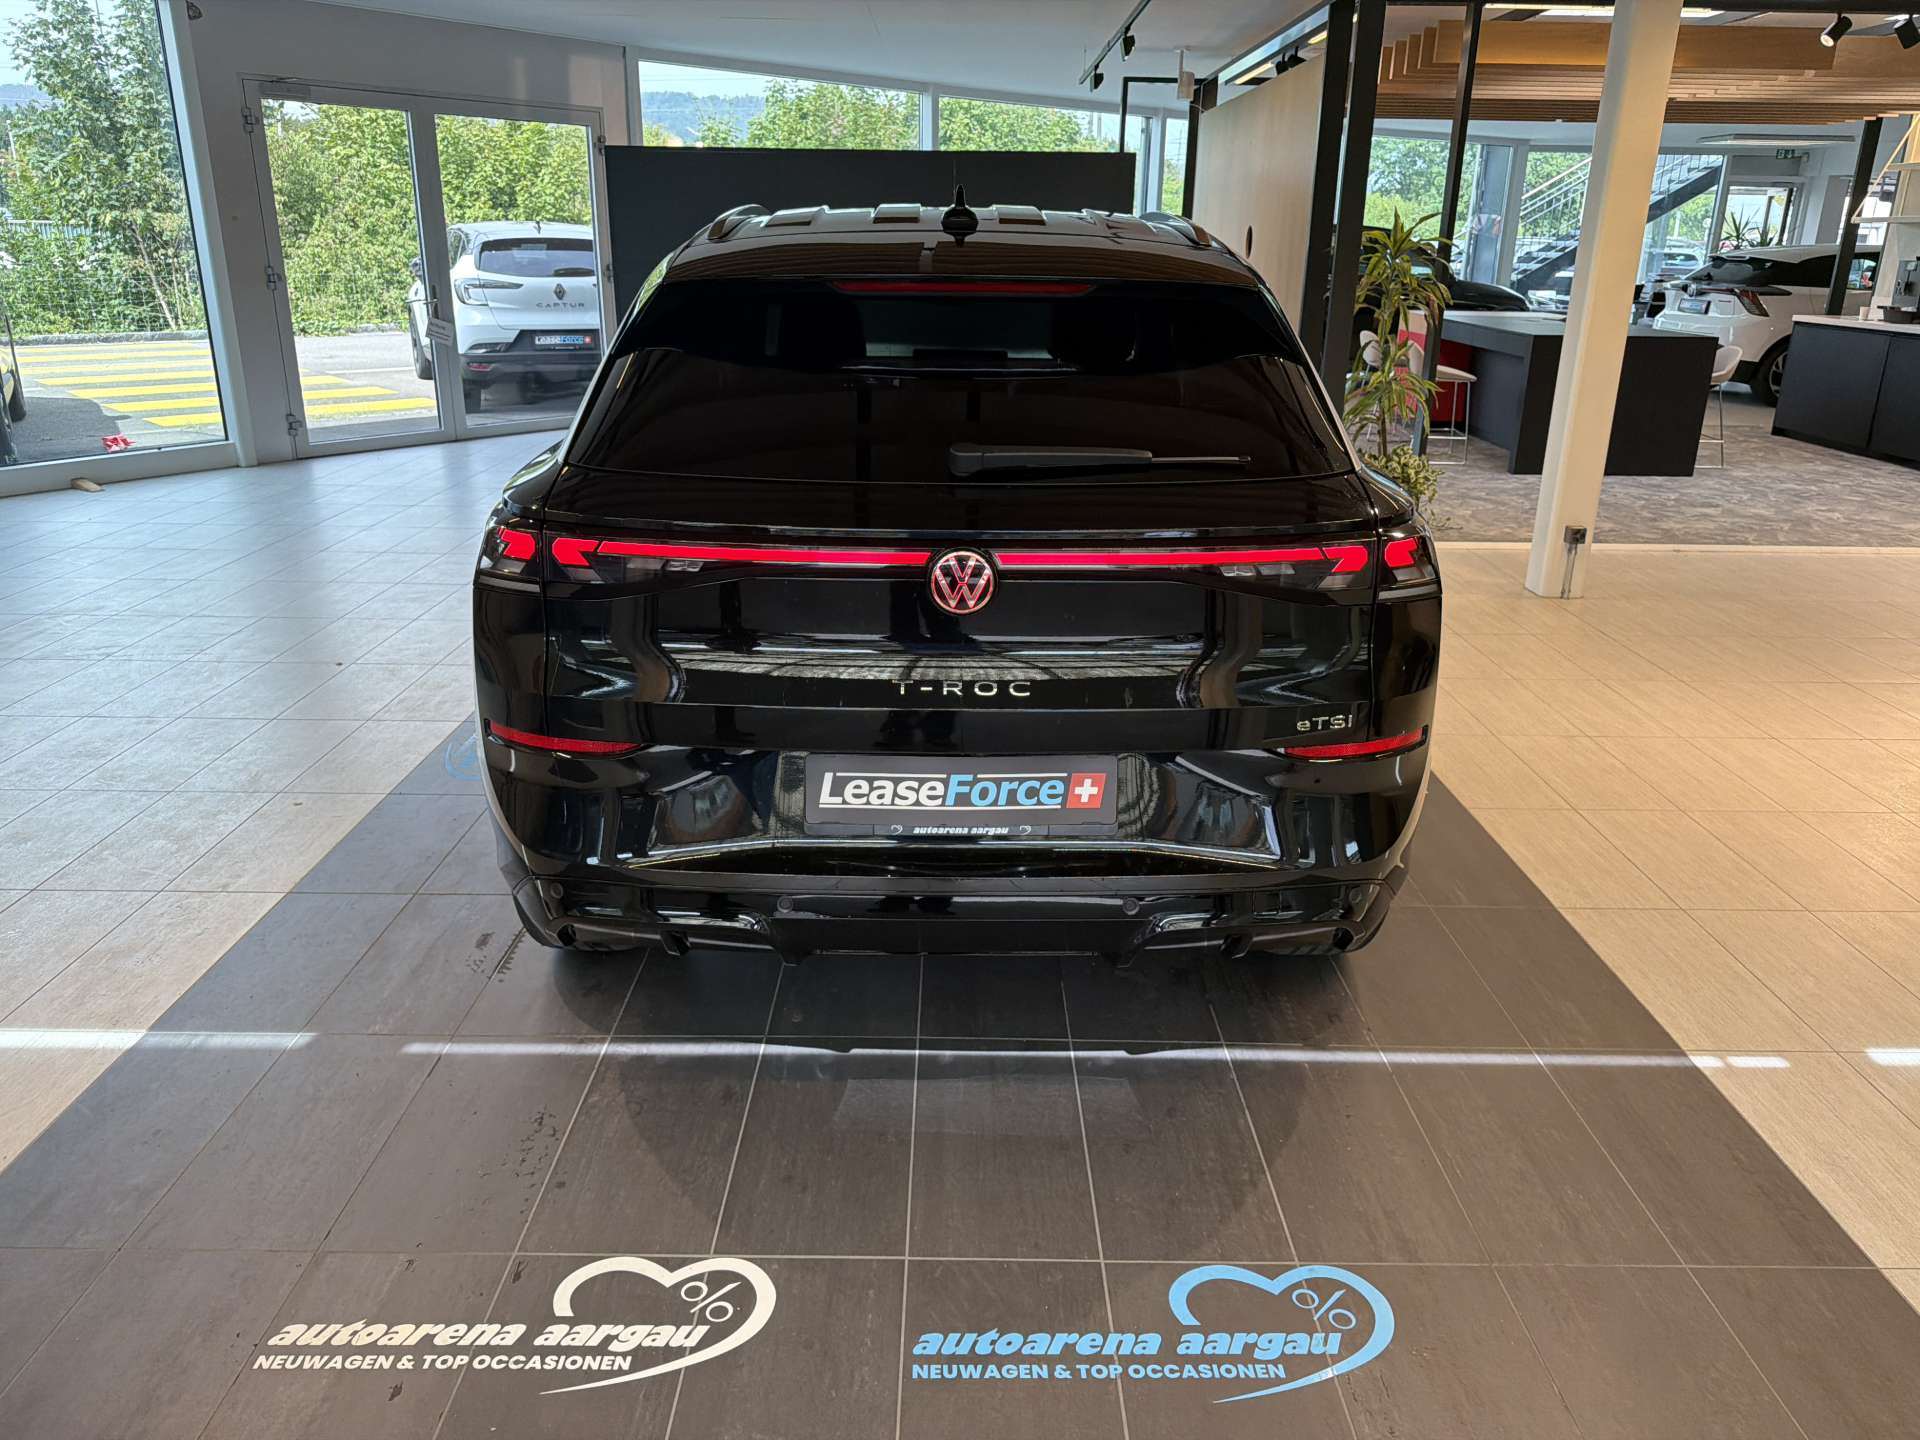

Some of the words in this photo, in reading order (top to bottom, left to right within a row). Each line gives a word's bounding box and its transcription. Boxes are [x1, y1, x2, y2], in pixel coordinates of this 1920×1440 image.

[892, 680, 1031, 696] T-ROC
[819, 772, 1064, 807] LeaseForce
[913, 826, 968, 834] autoarena
[970, 827, 1009, 835] aargau
[267, 1318, 527, 1347] autoarena
[533, 1323, 710, 1353] aargau
[911, 1327, 1161, 1357] autoarena
[1176, 1331, 1343, 1360] aargau
[252, 1354, 394, 1370] NEUWAGEN
[396, 1354, 416, 1370] &
[422, 1354, 469, 1370] TOP
[472, 1355, 632, 1372] OCCASIONEN
[911, 1363, 1049, 1380] NEUWAGEN
[1053, 1363, 1073, 1380] &
[1075, 1363, 1124, 1380] TOP
[1127, 1363, 1287, 1380] OCCASIONEN
